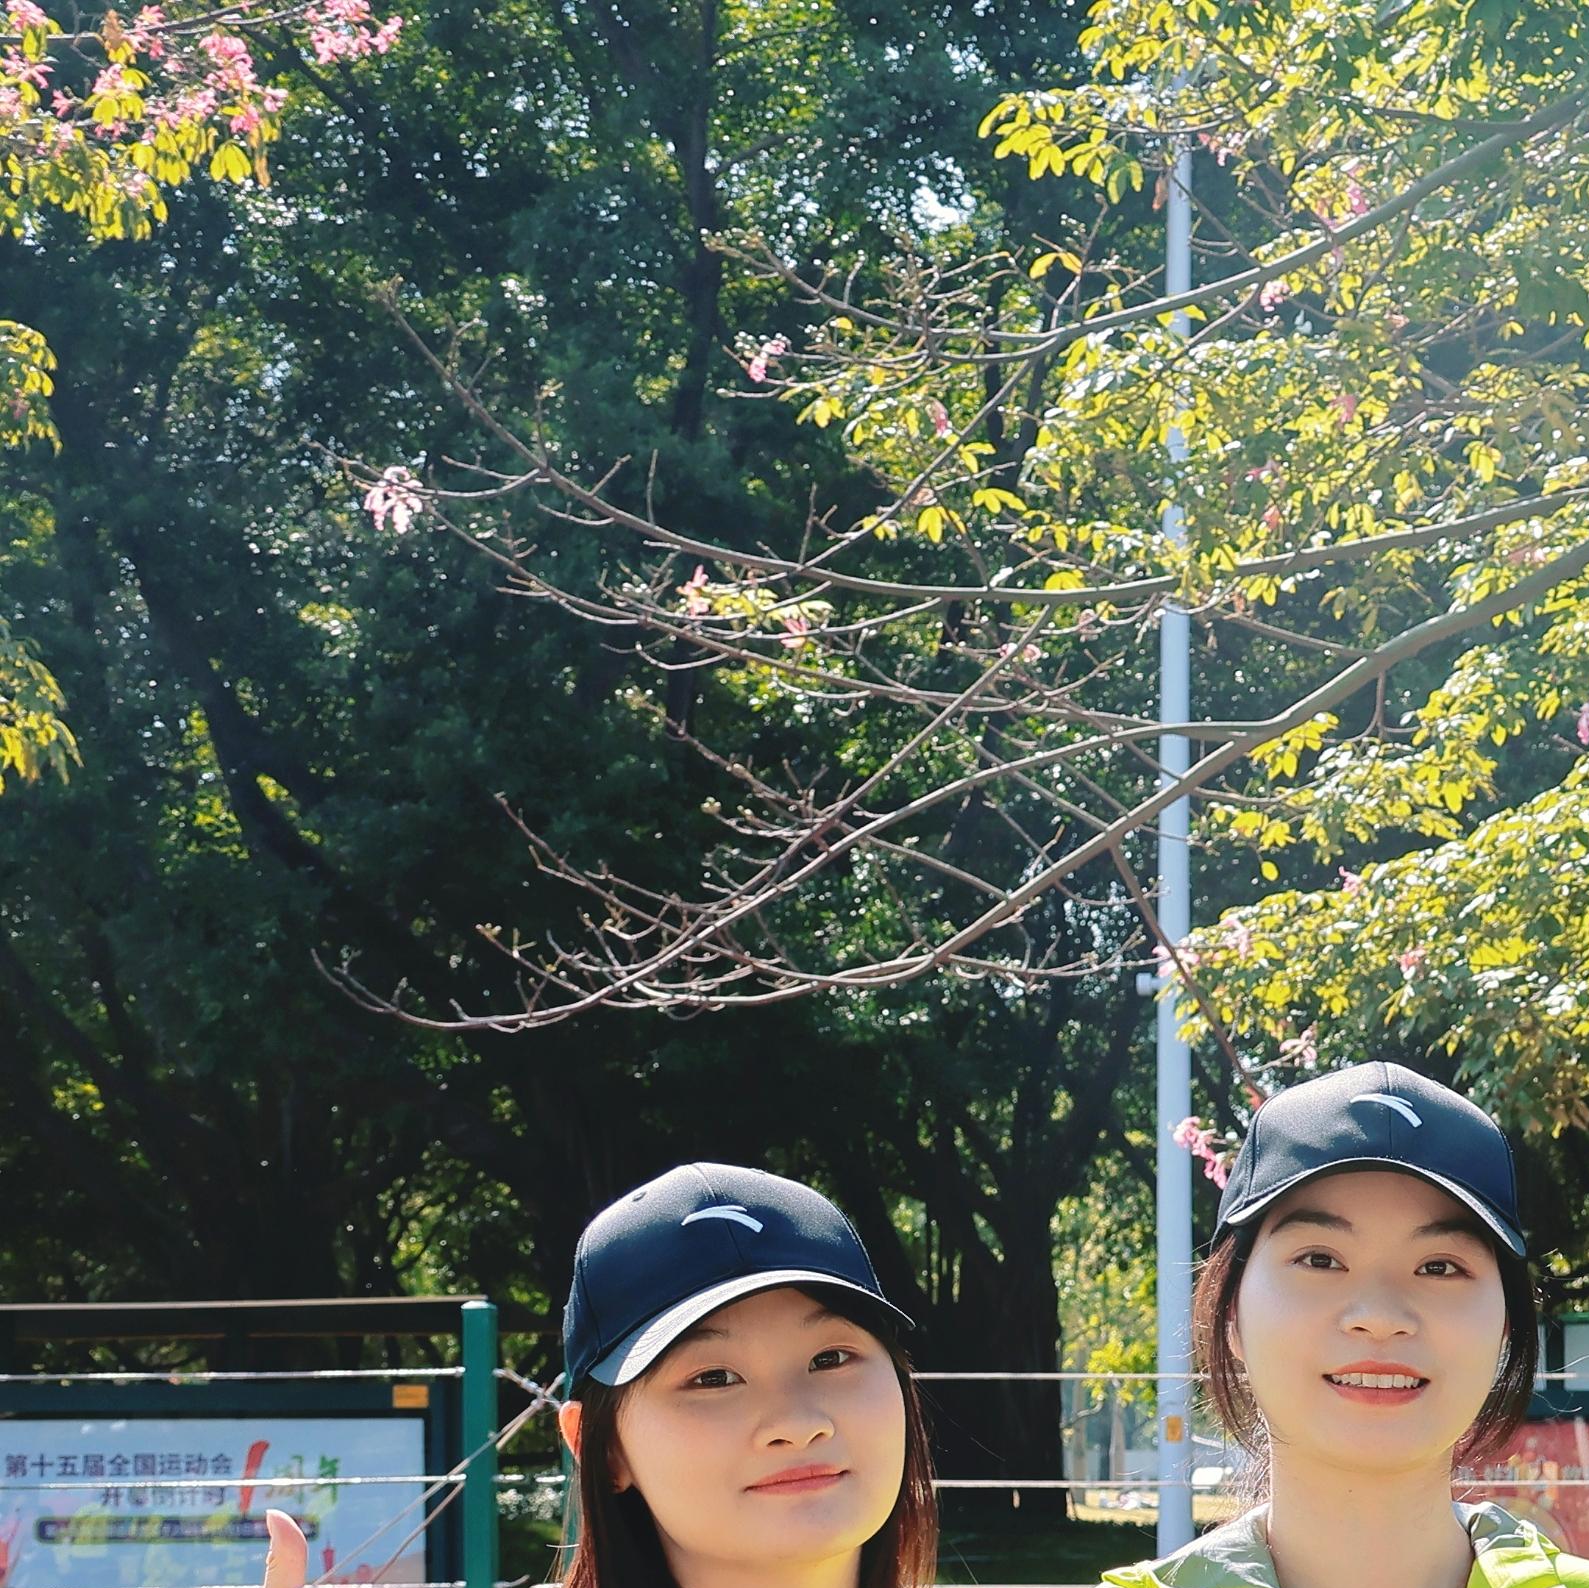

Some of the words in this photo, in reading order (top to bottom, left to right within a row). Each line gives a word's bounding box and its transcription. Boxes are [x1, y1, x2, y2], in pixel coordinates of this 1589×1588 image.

[5, 1453, 233, 1478] 第十五届全国运动会
